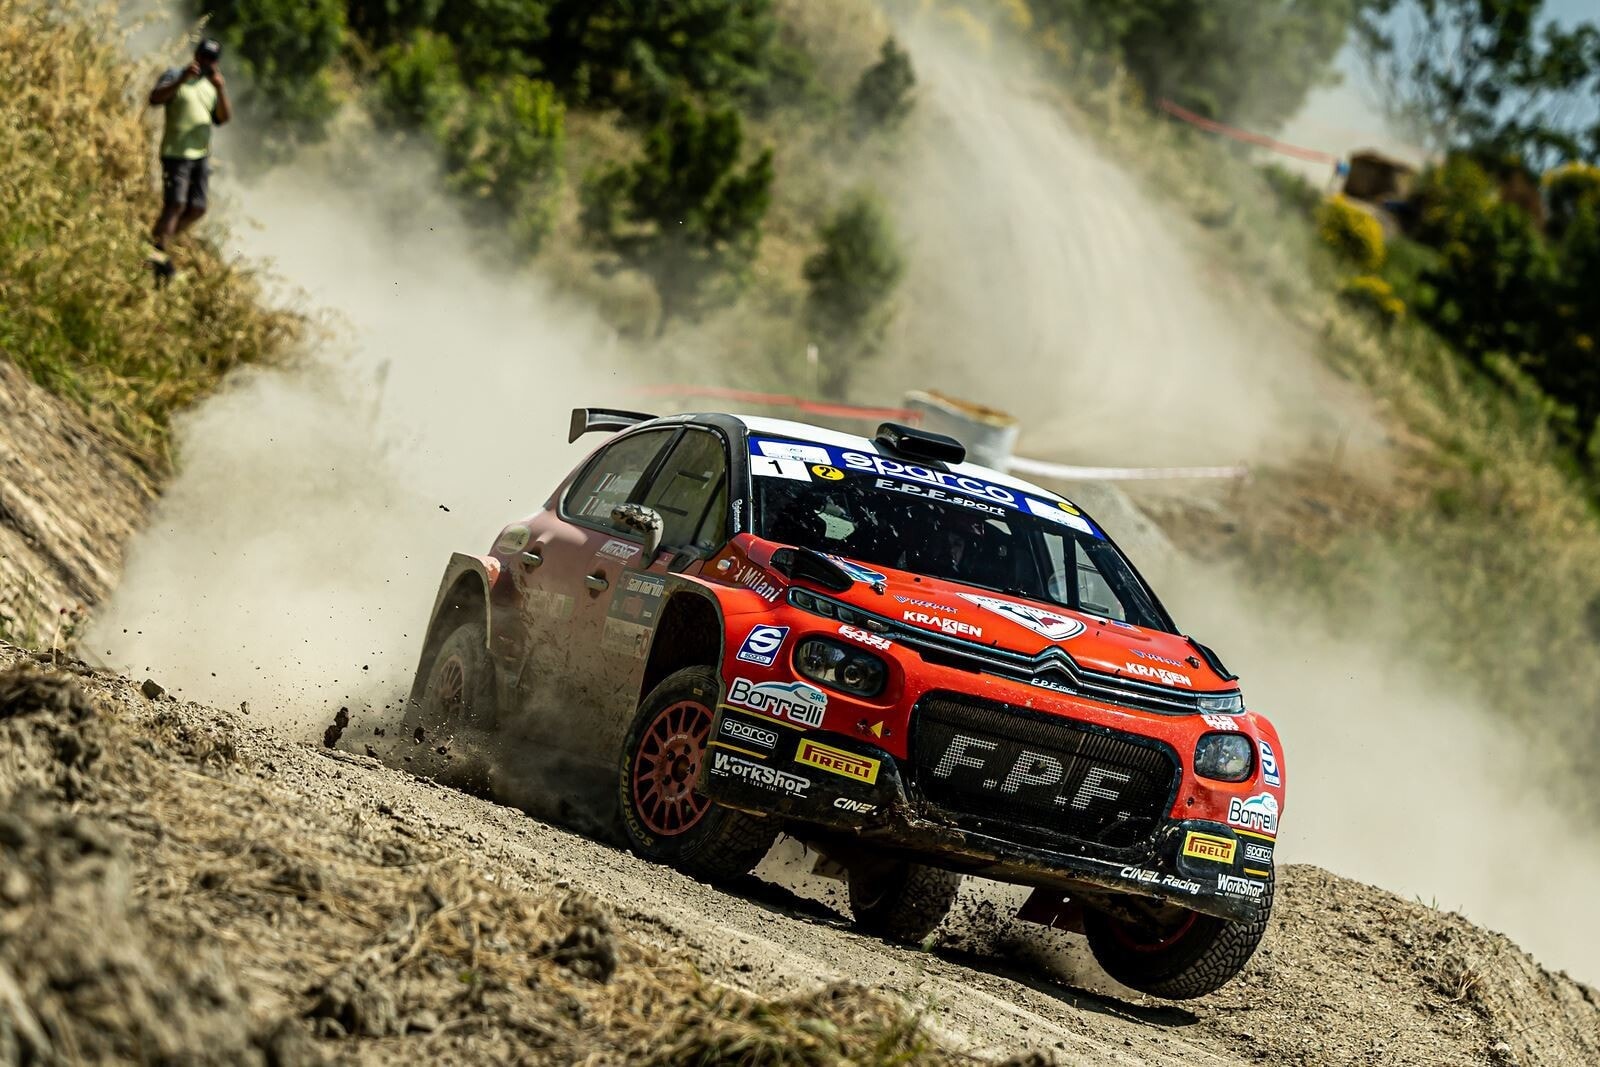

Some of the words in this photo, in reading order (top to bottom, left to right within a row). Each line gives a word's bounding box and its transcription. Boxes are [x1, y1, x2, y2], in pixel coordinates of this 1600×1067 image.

[768, 460, 783, 474] 1
[841, 451, 1017, 505] sparco
[741, 566, 783, 603] Milani
[903, 611, 983, 638] KRAKEN
[1126, 662, 1192, 687] KRAKEN
[730, 680, 825, 727] Borrelli
[810, 691, 826, 704] SRL
[723, 720, 777, 746] sparco
[802, 743, 873, 779] PIRELLI
[1230, 799, 1278, 831] Borrelli
[1187, 836, 1233, 860] PIRELLI
[1246, 844, 1272, 863] sparco
[1162, 874, 1201, 895] Racing
